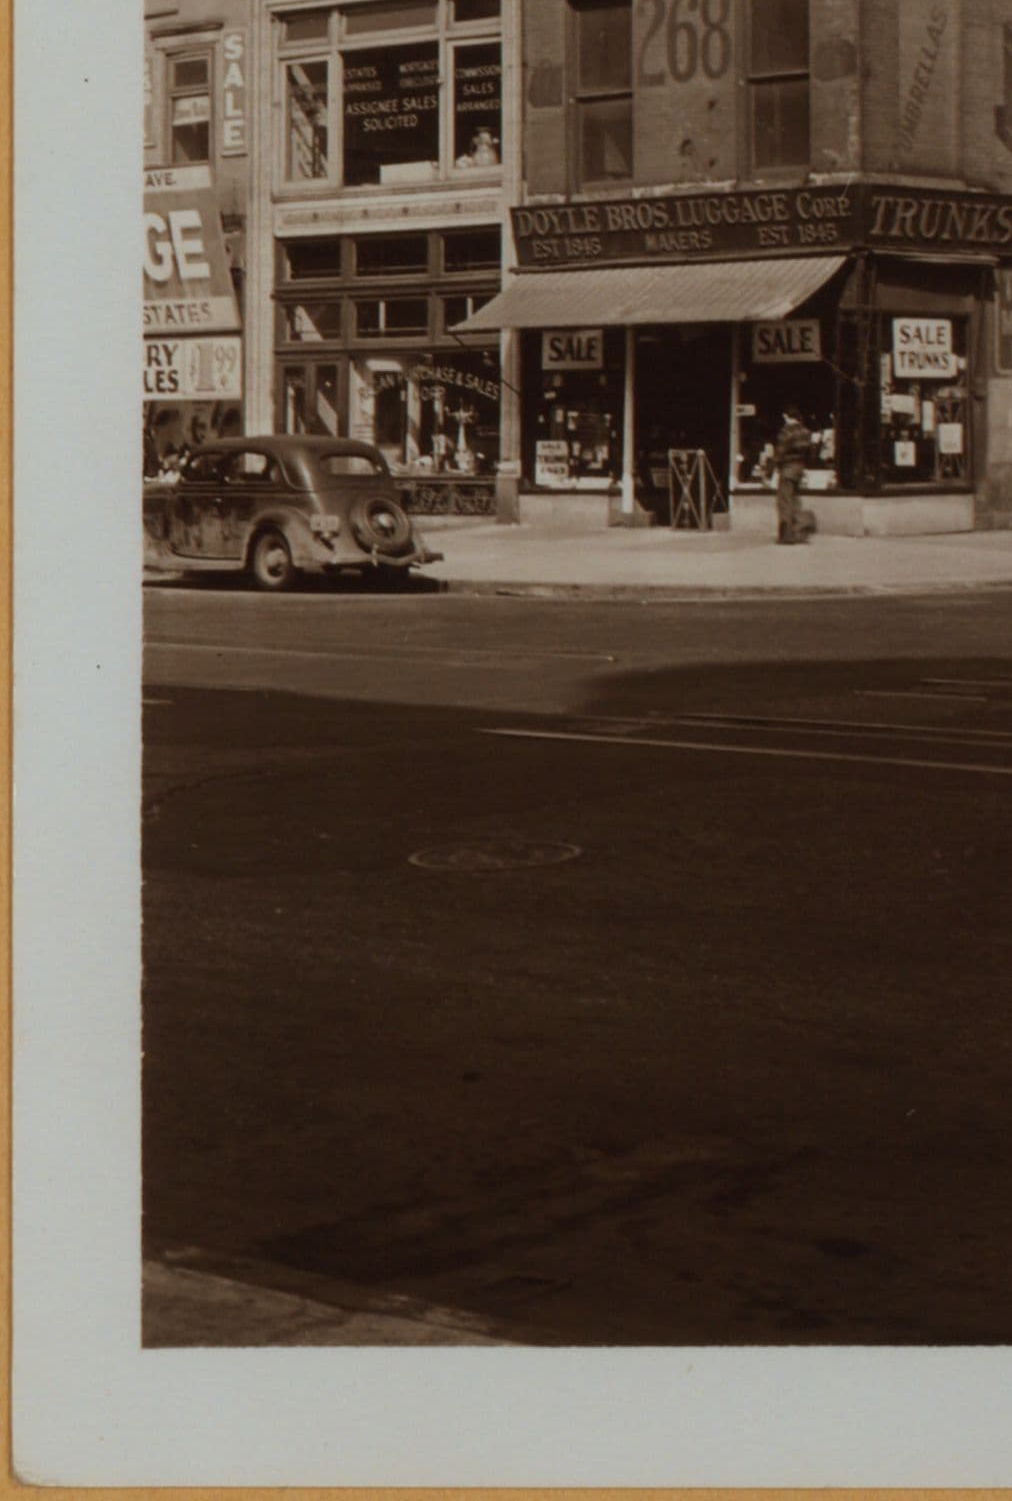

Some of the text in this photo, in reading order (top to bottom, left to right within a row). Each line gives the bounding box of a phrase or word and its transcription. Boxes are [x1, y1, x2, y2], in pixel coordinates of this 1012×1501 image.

[222, 33, 245, 148] SALE
[463, 82, 495, 96] SALES
[402, 96, 438, 112] SALES
[362, 115, 418, 132] SOLICITED
[517, 205, 602, 237] DOYLE
[677, 193, 790, 228] LUGGAGE
[143, 209, 211, 283] GE
[644, 230, 714, 252] MAKERS
[758, 226, 790, 246] EST
[758, 328, 815, 355] SALE
[899, 324, 947, 346] SALE
[549, 336, 598, 362] SALE
